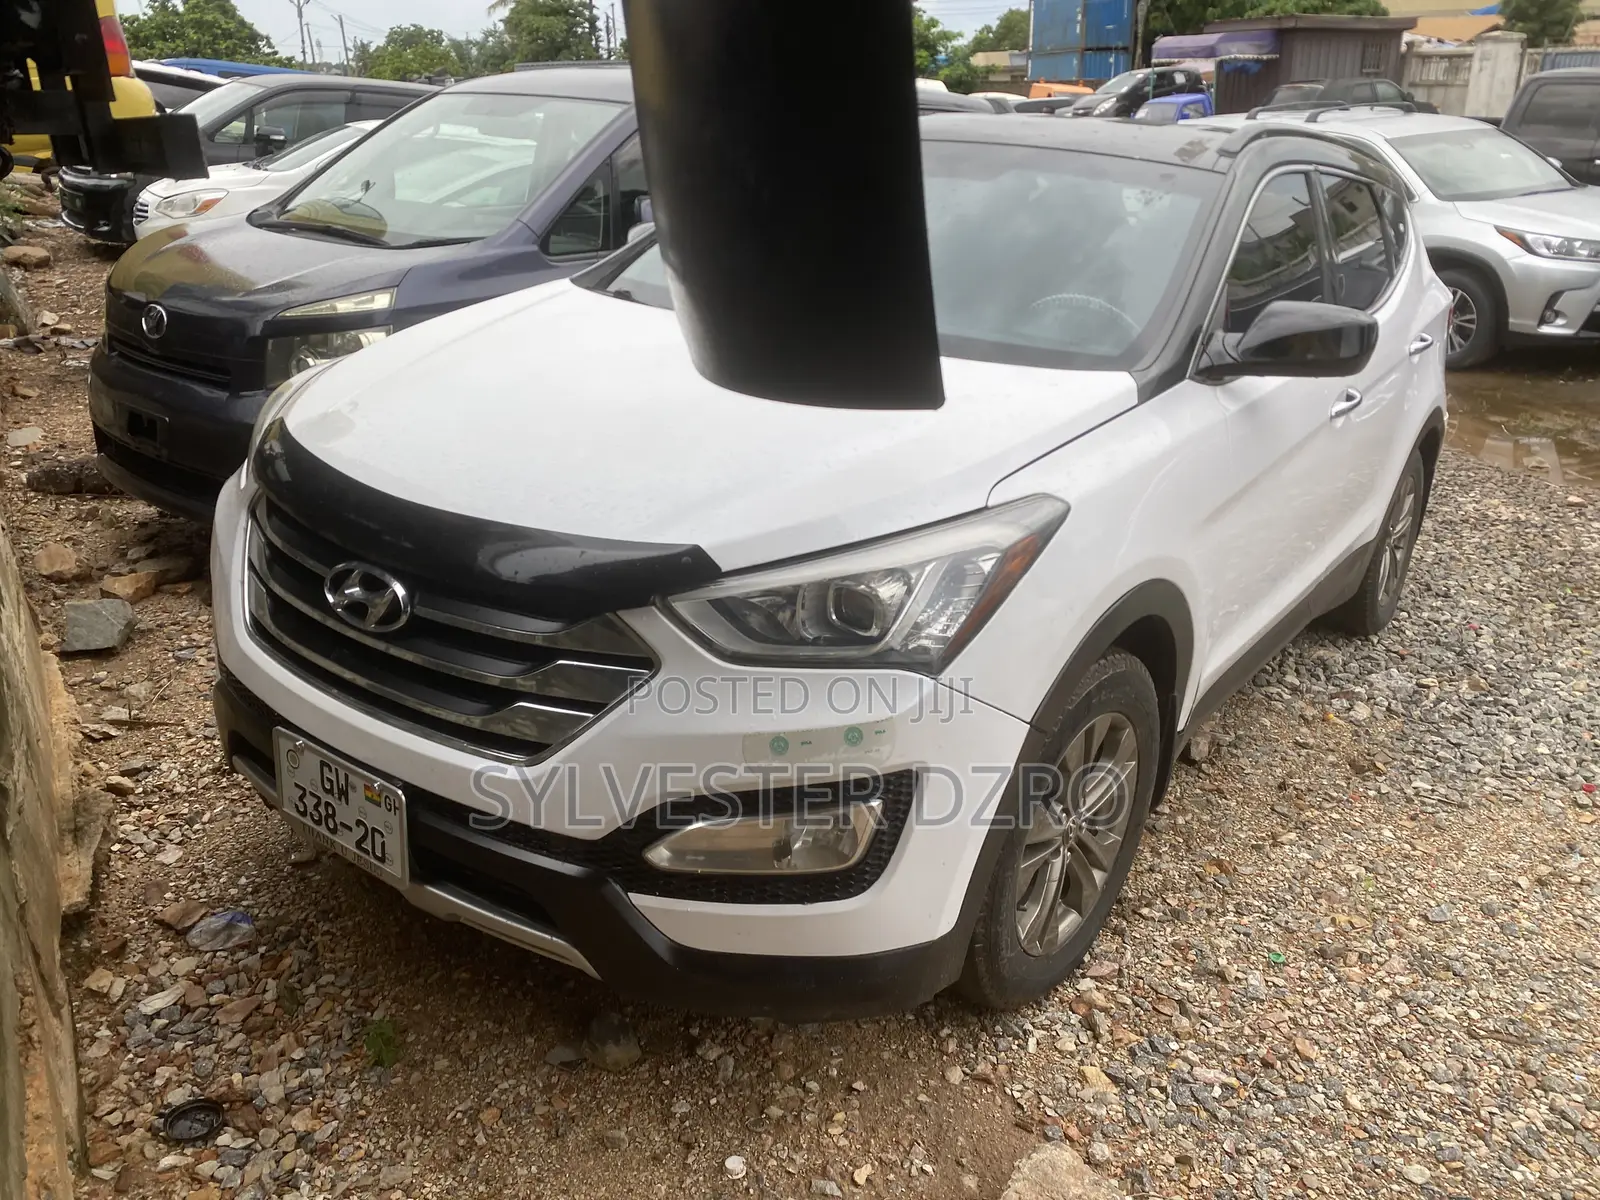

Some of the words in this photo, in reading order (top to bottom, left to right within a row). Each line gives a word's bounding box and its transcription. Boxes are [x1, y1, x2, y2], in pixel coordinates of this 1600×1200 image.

[319, 759, 350, 806] GW
[294, 781, 386, 864] 338-20
[301, 821, 336, 850] THANK
[340, 845, 348, 857] U
